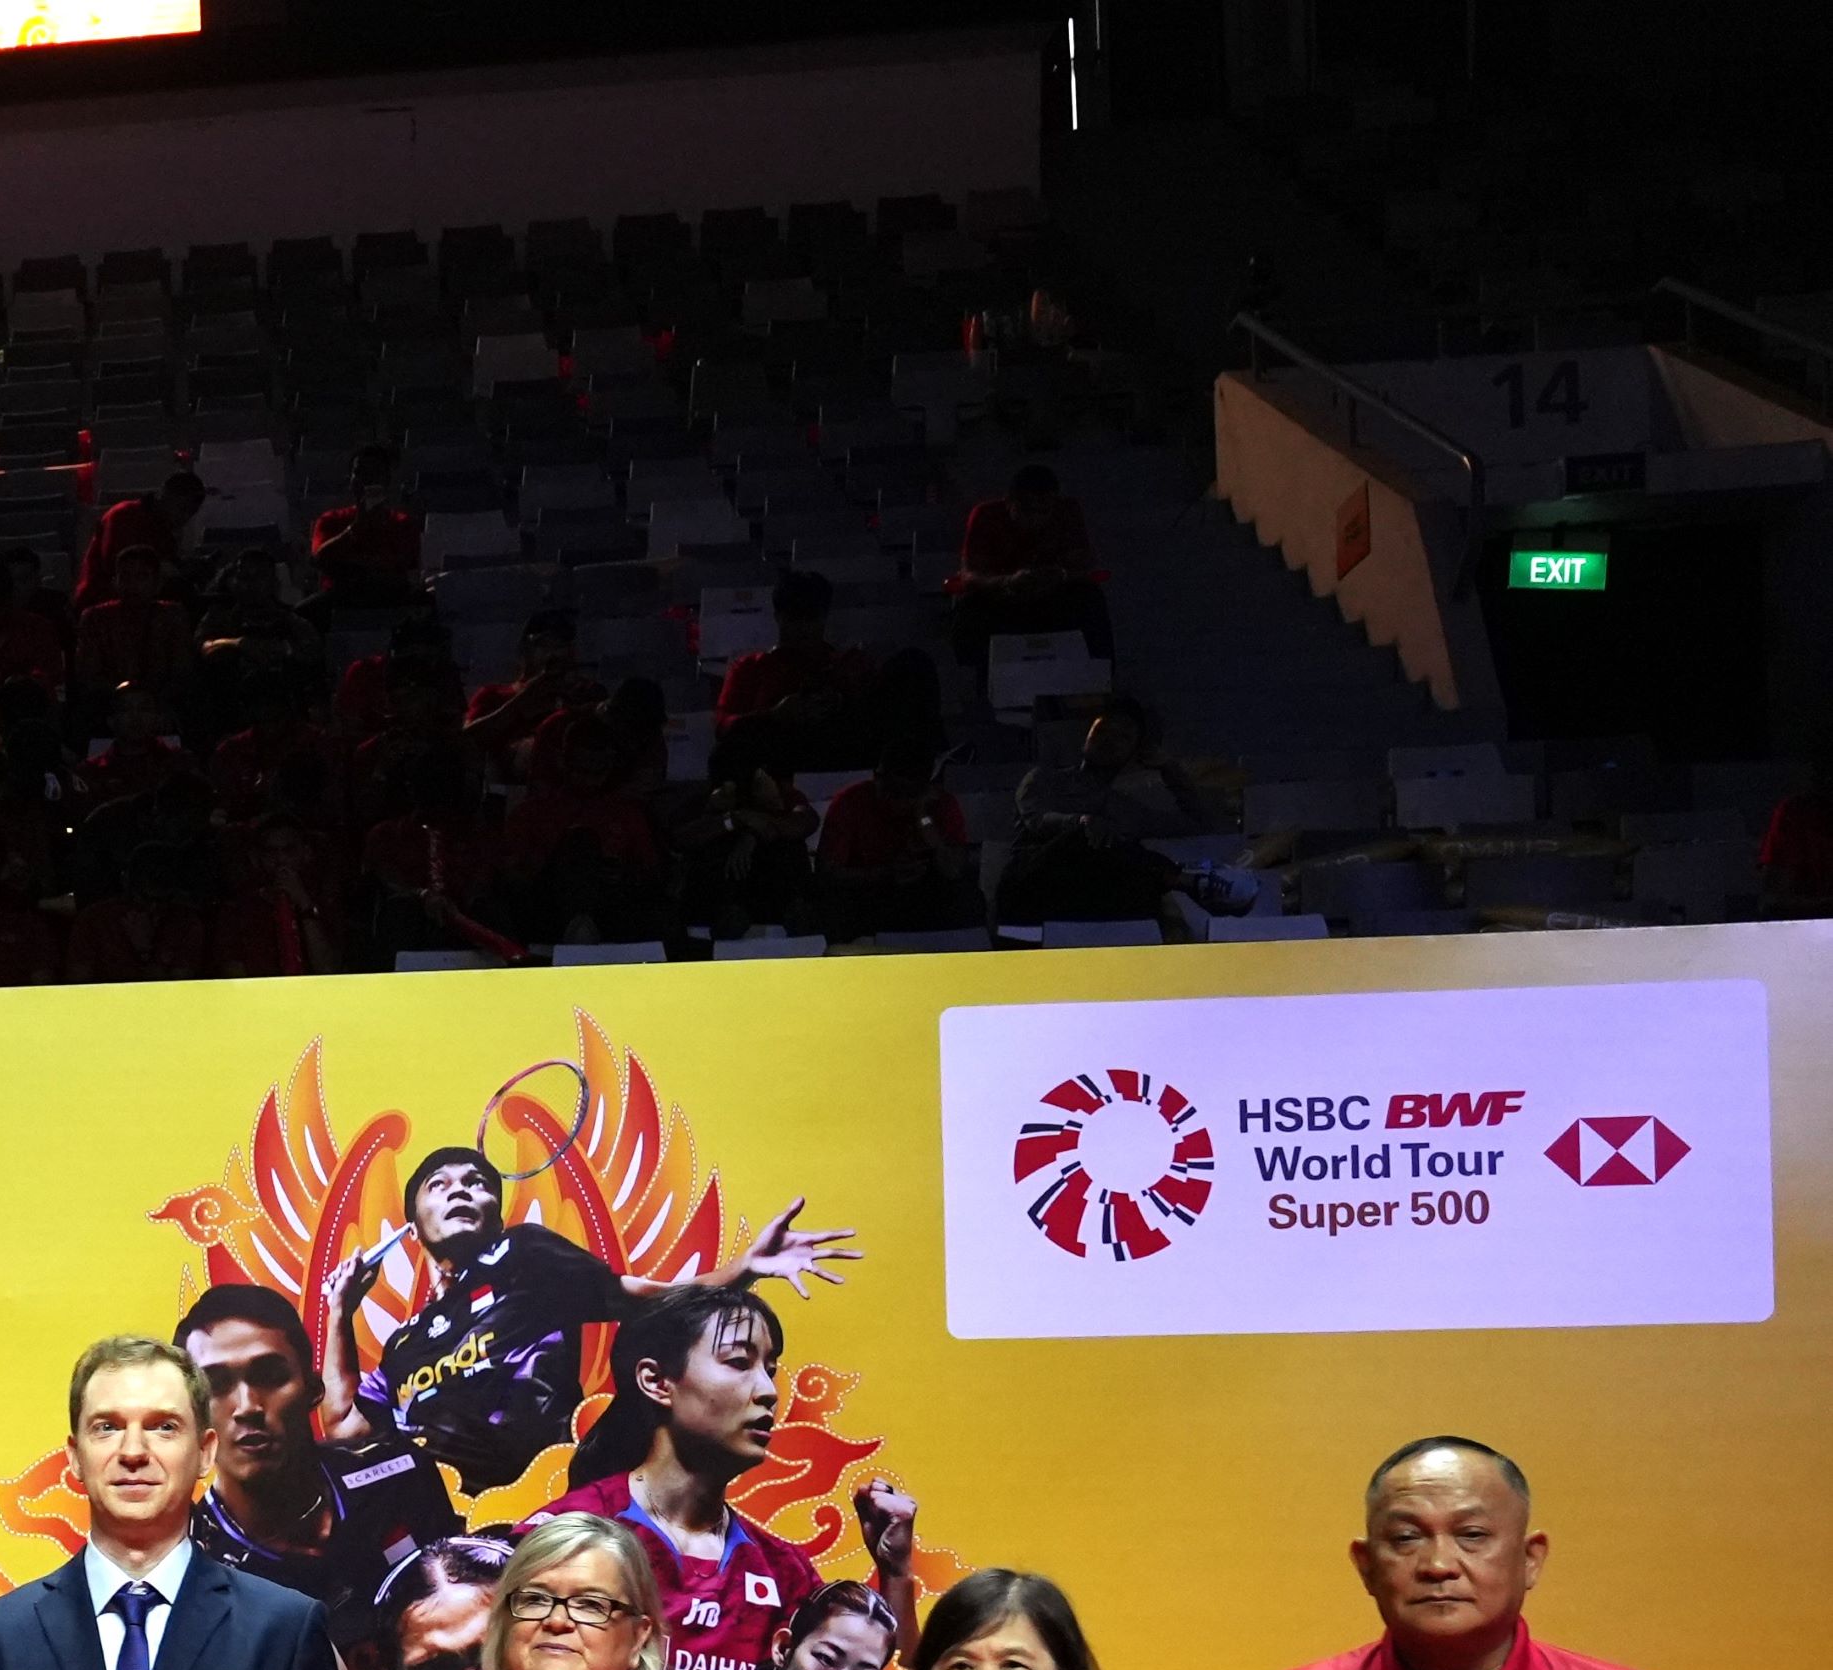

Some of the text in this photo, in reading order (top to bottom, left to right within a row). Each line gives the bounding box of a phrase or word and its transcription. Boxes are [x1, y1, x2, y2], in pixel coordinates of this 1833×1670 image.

[1493, 360, 1587, 428] 14
[1530, 558, 1586, 584] EXIT
[1239, 1090, 1526, 1133] HSBC BWF
[1253, 1142, 1504, 1181] World Tour
[1268, 1190, 1490, 1236] Super 500
[347, 1458, 411, 1486] SCARLETT
[681, 1597, 721, 1628] JTB
